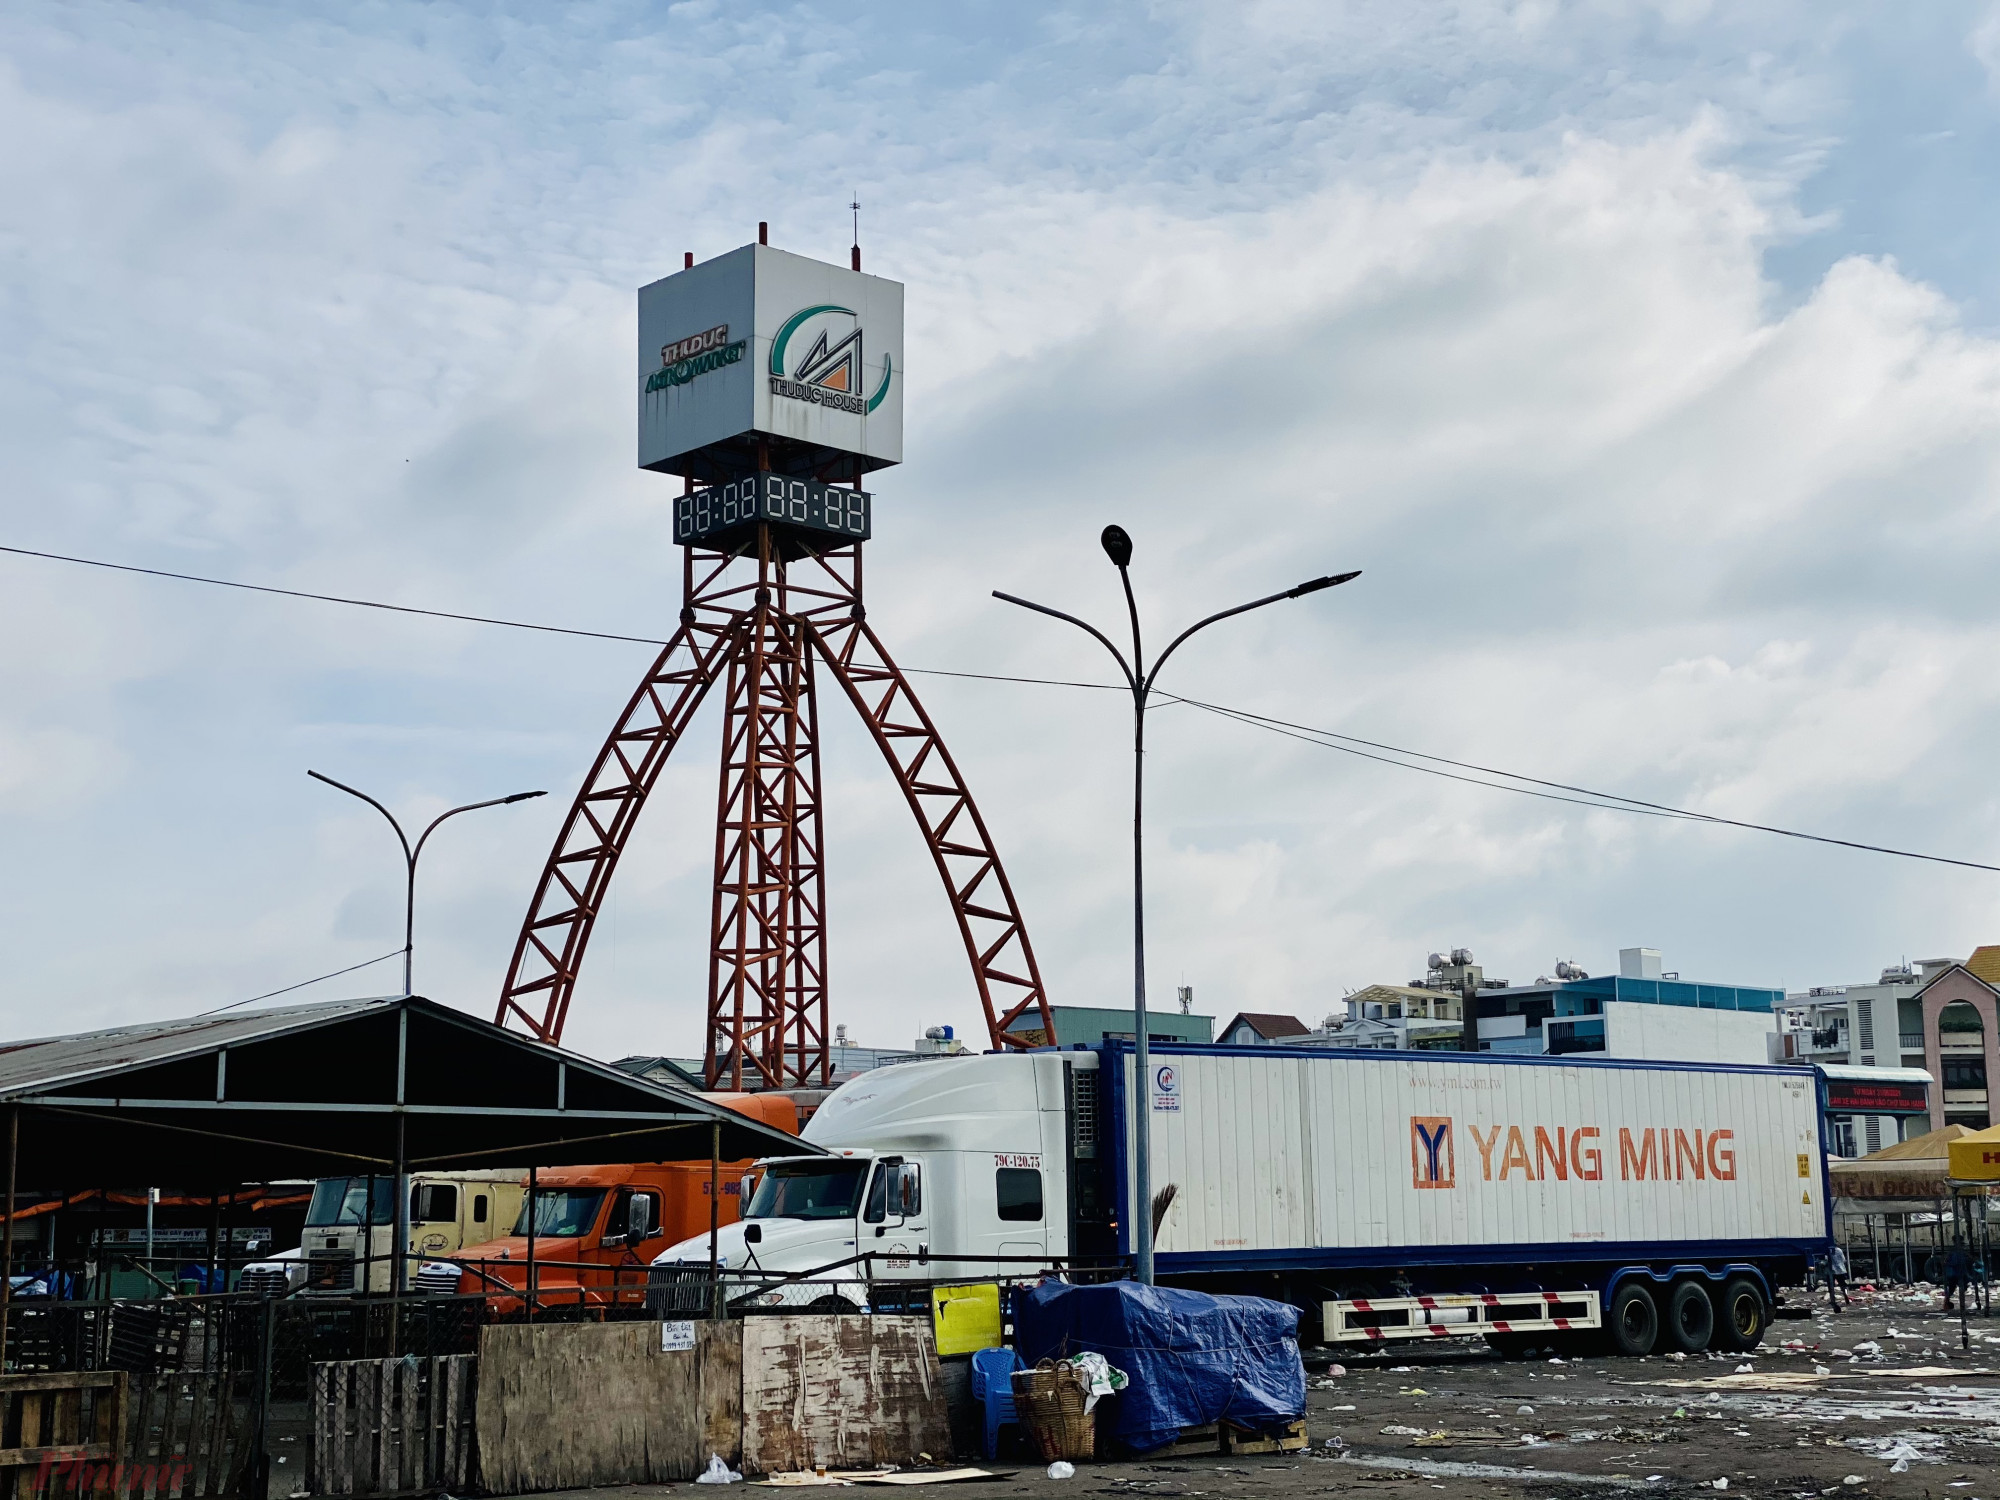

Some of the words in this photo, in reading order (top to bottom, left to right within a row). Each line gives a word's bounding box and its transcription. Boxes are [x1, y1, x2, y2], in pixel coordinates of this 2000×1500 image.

[770, 377, 821, 403] THUDUC
[822, 390, 864, 414] HOUSE
[994, 1154, 1040, 1168] 79C-120.75
[1468, 1125, 1603, 1181] YANG
[1618, 1127, 1737, 1181] MING
